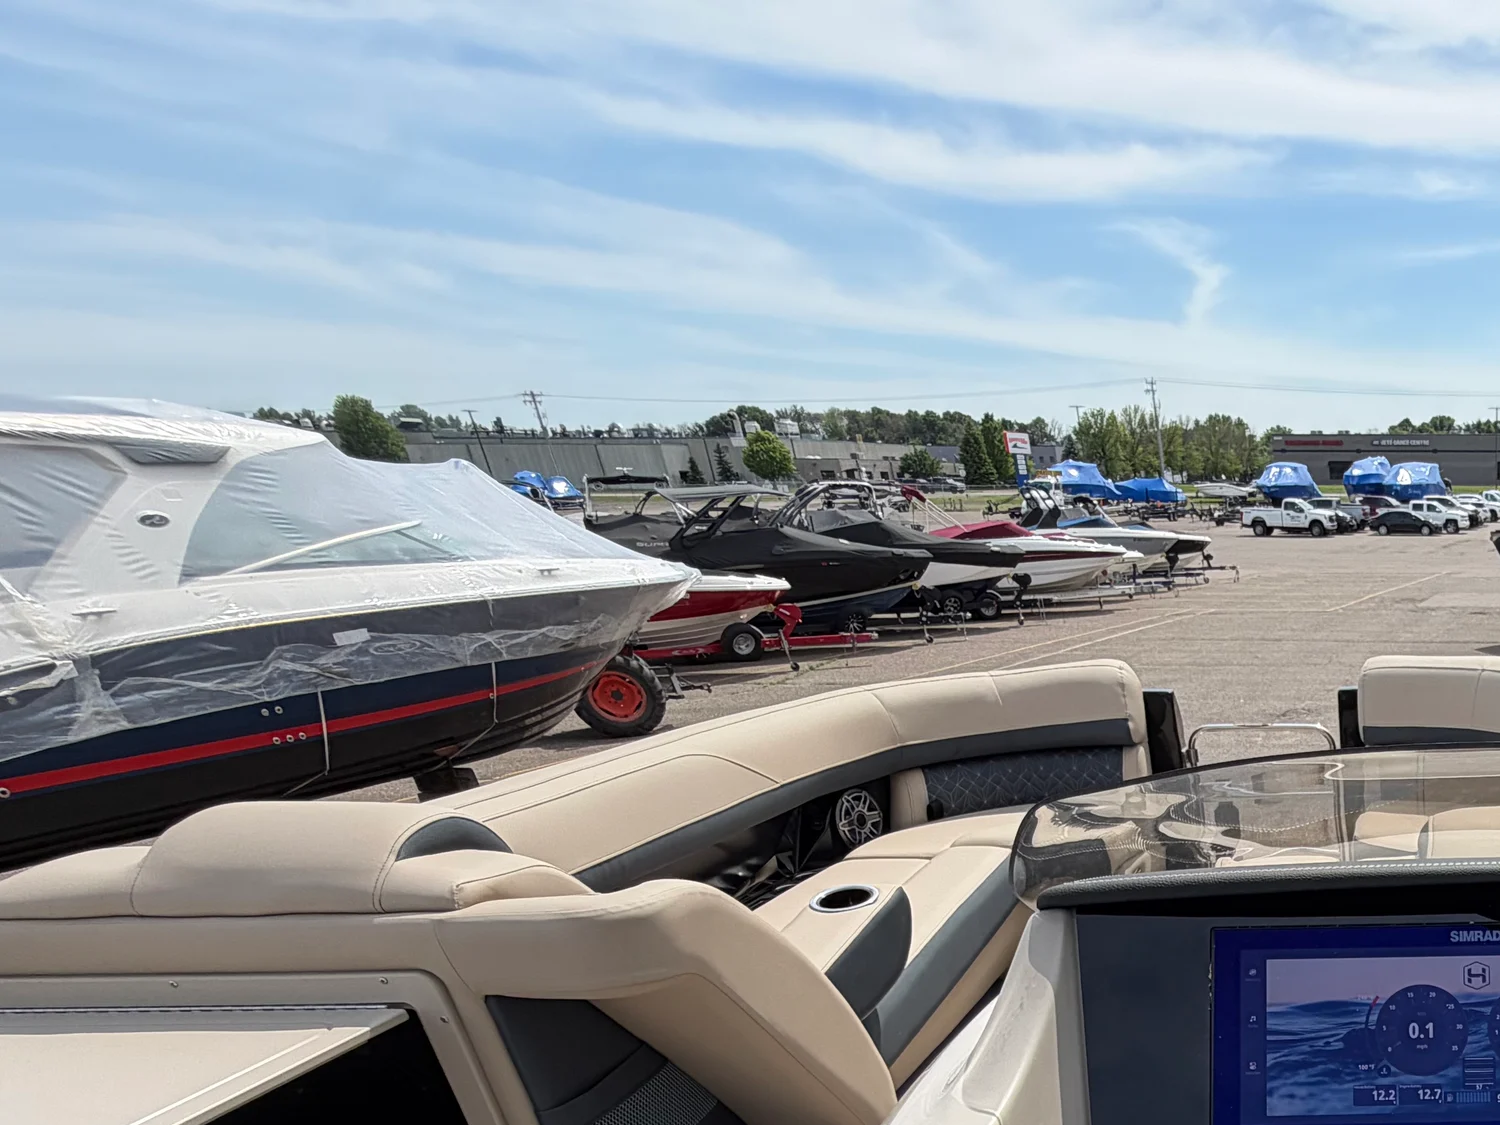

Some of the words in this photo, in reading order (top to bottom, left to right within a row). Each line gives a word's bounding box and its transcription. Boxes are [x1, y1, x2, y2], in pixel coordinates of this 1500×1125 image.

[1409, 1022, 1434, 1039] 0.1
[1372, 1090, 1396, 1101] 12.2
[1418, 1089, 1441, 1100] 12.7
